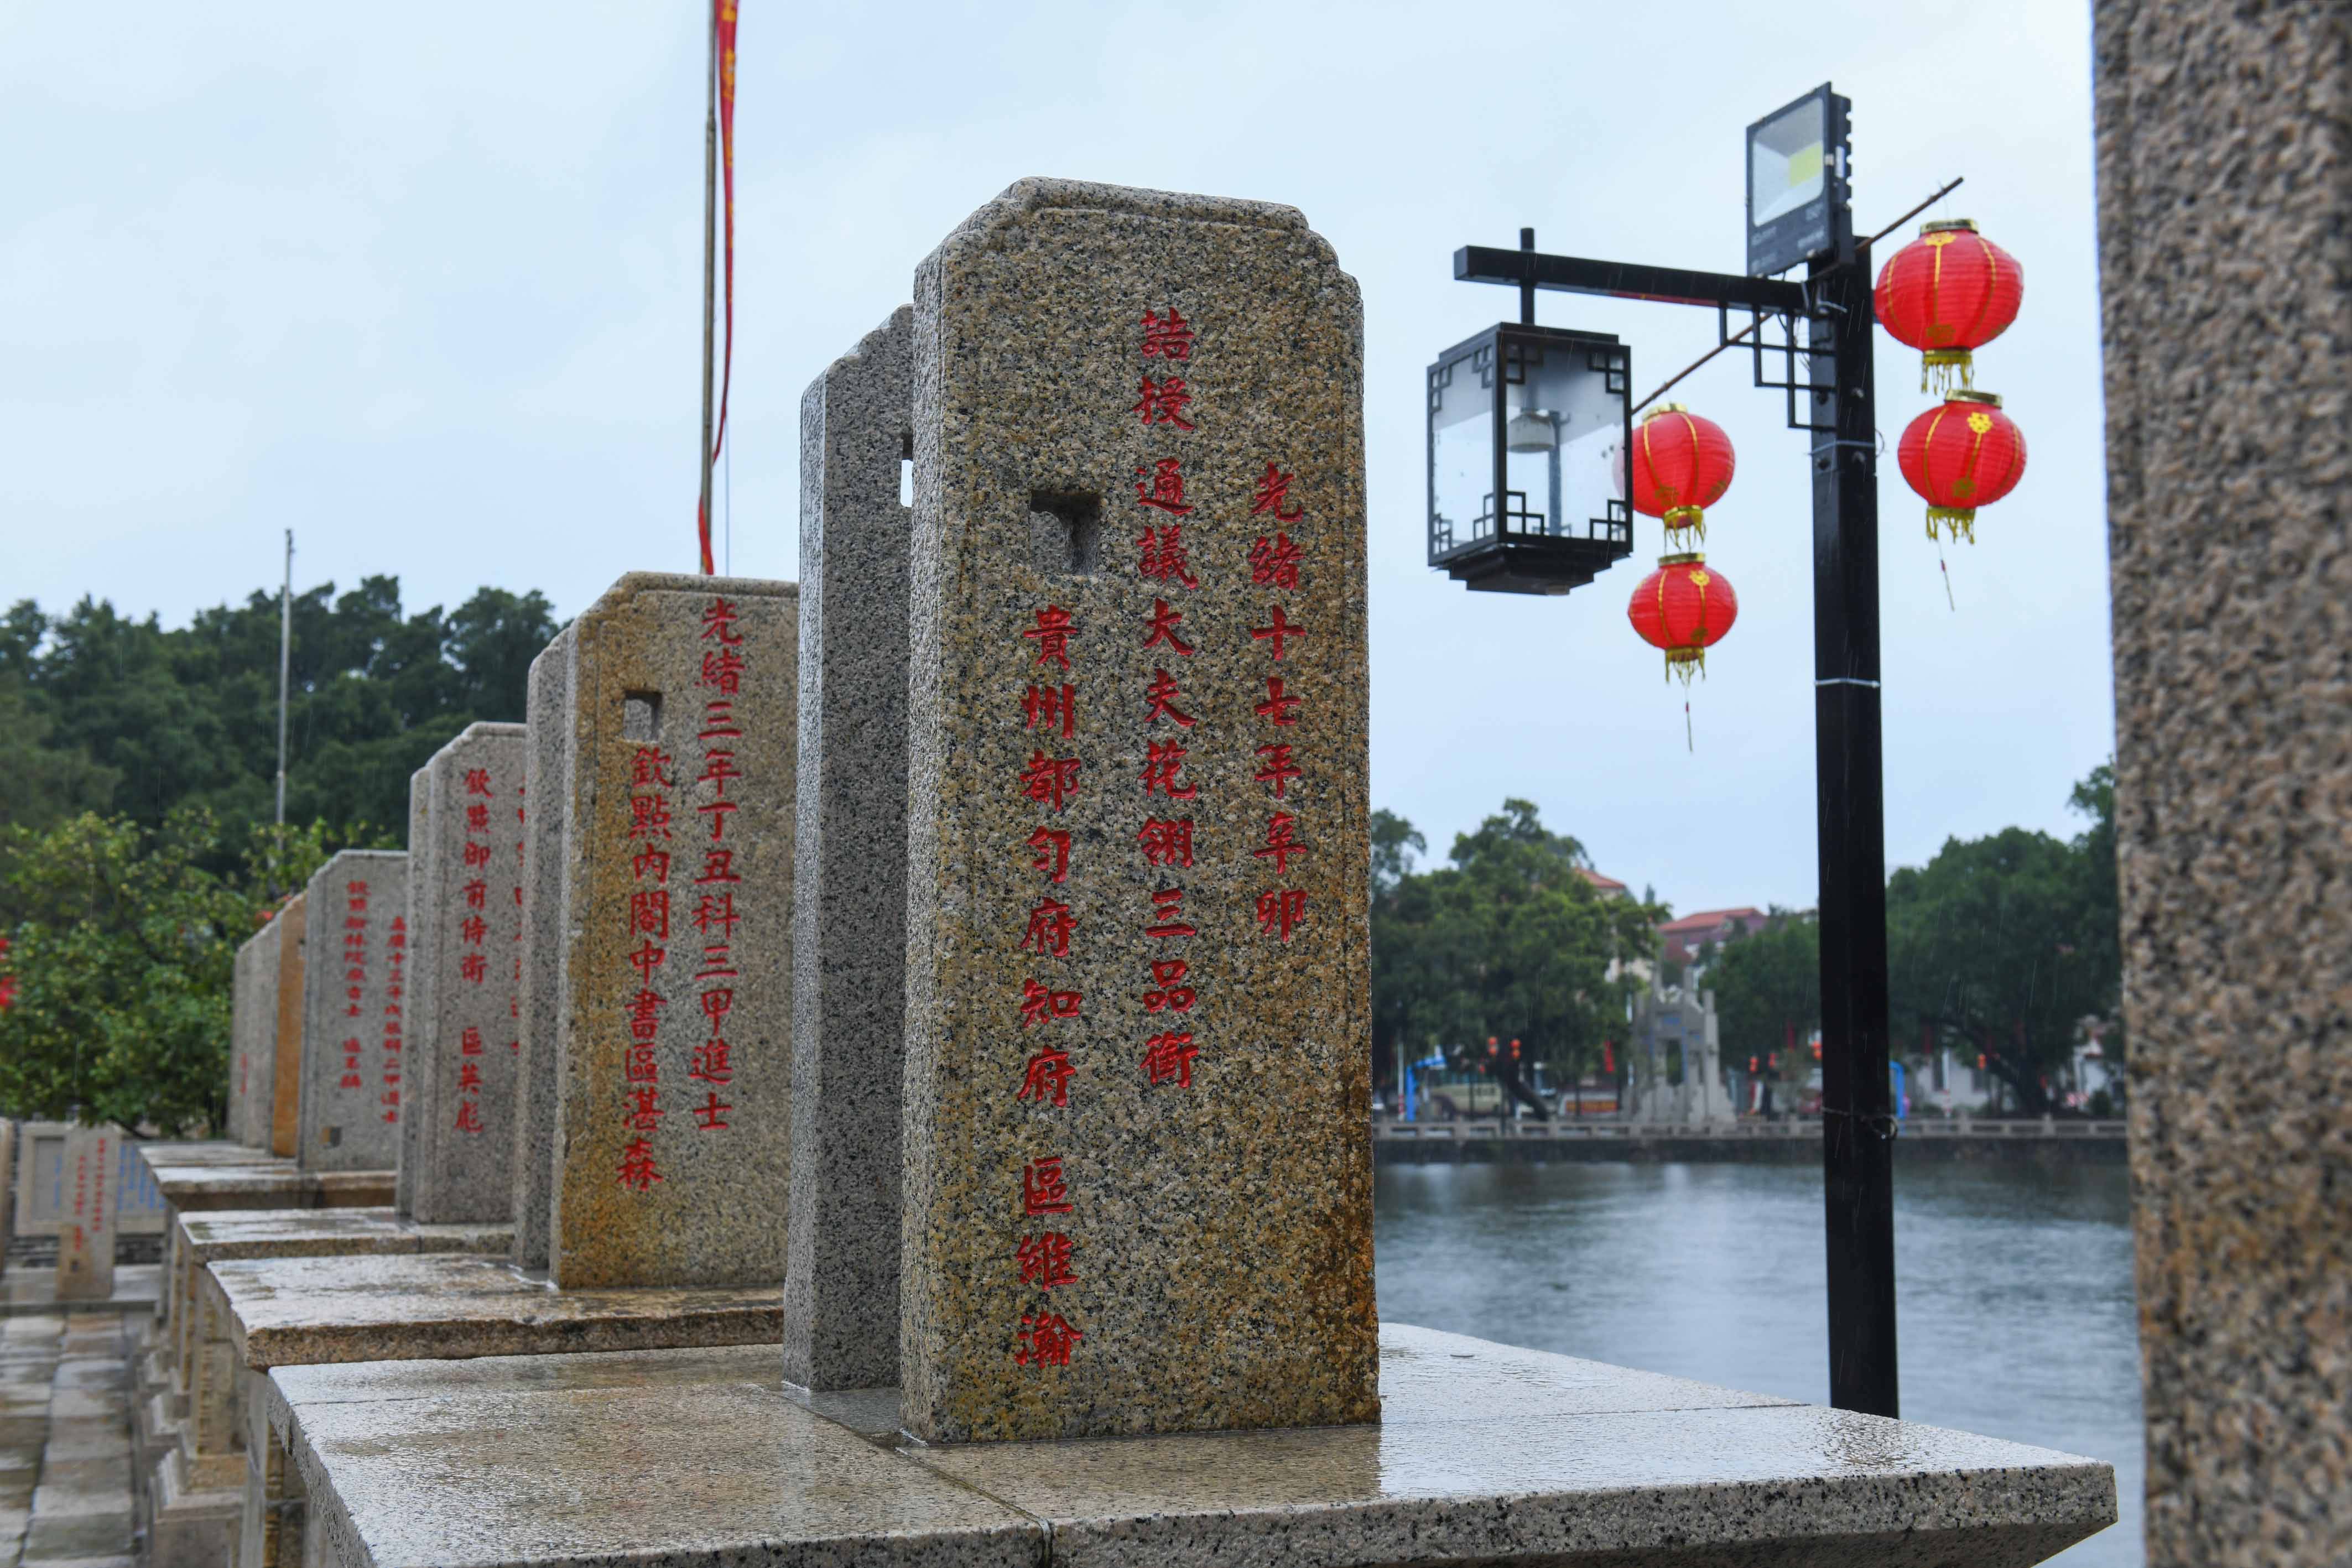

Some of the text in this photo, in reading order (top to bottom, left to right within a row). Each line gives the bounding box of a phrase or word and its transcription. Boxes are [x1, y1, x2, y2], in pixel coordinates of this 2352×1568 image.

[689, 598, 745, 1131] 光緒三年丁丑科三甲進士
[1248, 461, 1309, 944] 光緒十七年辛卯
